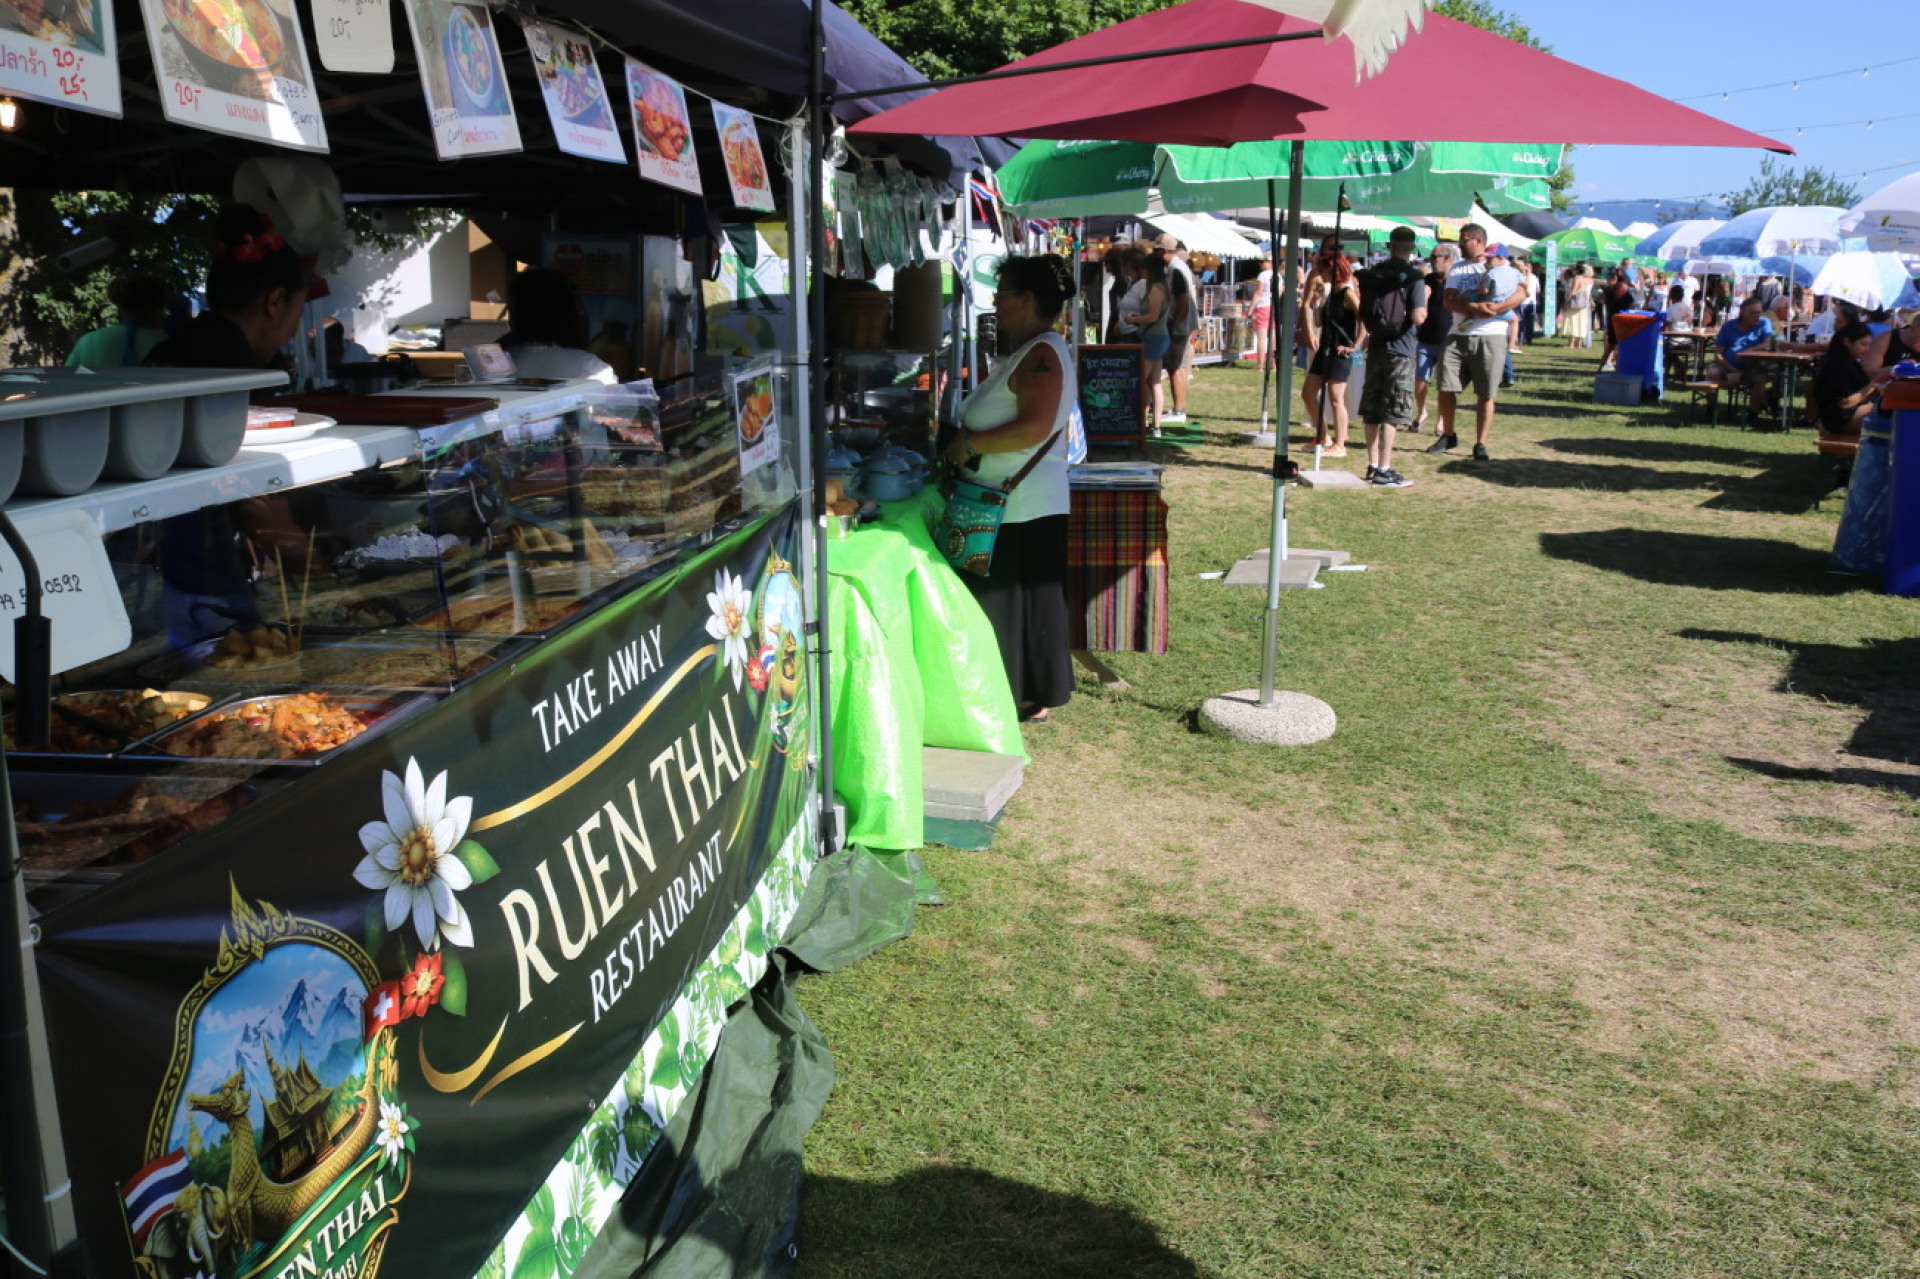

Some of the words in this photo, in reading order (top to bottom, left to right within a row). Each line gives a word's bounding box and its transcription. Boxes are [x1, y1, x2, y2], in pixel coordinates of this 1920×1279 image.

[45, 574, 83, 593] 0592
[531, 668, 601, 753] TAKE
[608, 624, 666, 706] AWAY
[499, 778, 657, 1013] RUEN
[649, 693, 748, 844] THAI
[590, 829, 723, 1024] RESTAURANT
[317, 1174, 387, 1262] THAI
